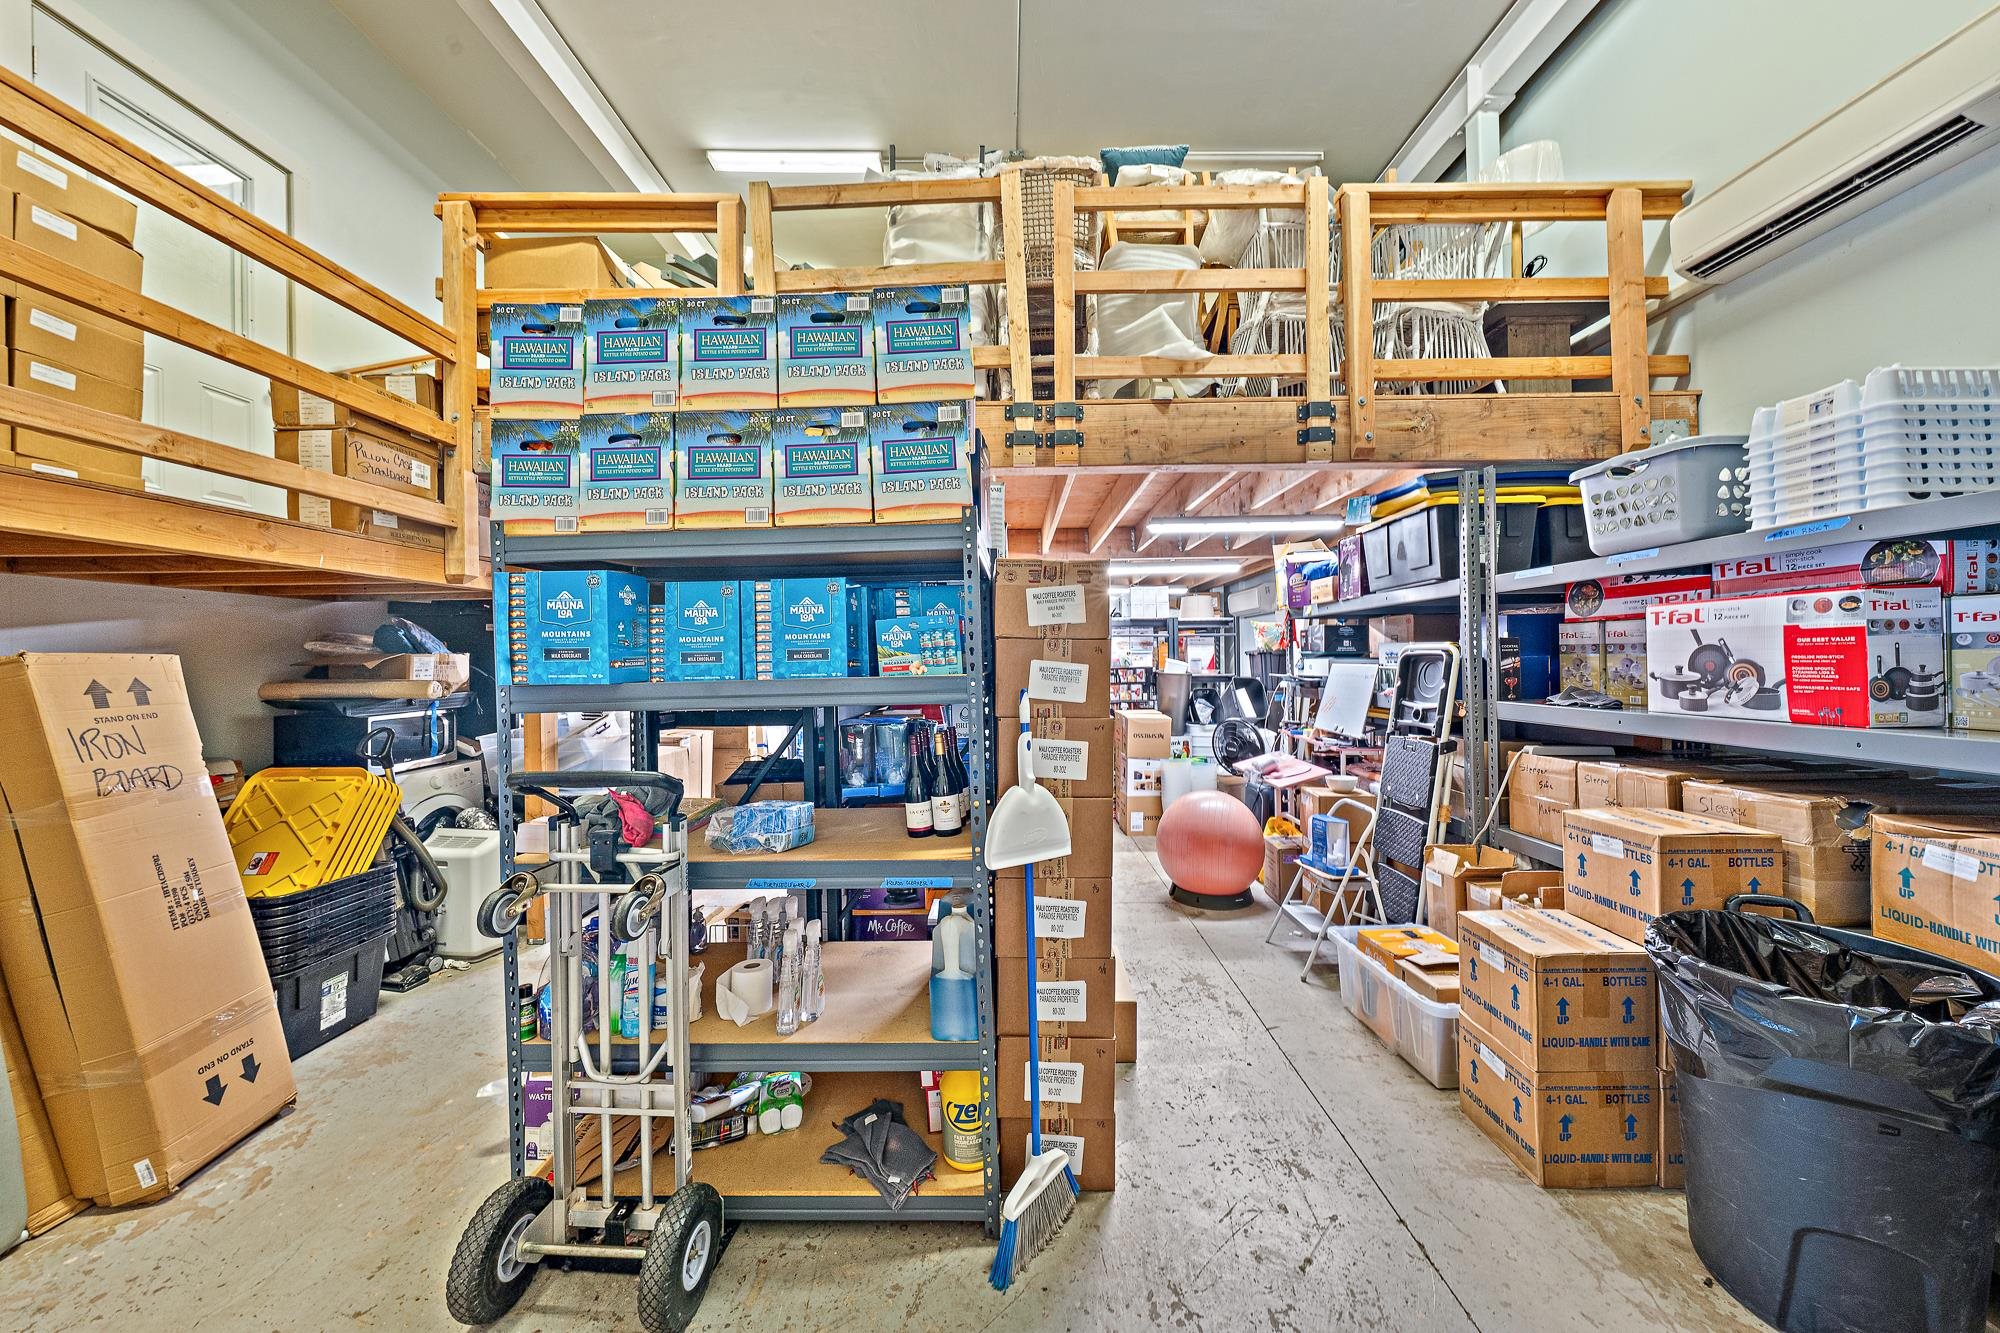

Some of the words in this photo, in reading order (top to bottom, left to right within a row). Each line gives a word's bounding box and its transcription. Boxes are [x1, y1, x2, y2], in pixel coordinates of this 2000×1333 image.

[885, 360, 928, 373] ISLAND
[933, 358, 964, 370] PACK
[594, 371, 636, 382] ISLAND
[640, 369, 670, 381] PACK
[691, 368, 735, 380] ISLAND
[739, 367, 769, 379] PACK
[500, 377, 541, 389] ISLAND
[546, 377, 575, 389] PACK
[350, 441, 389, 464] PILLOW
[783, 484, 826, 496] ISLAND
[831, 482, 862, 495] PACK
[882, 480, 925, 493] ISLAND
[930, 477, 961, 490] PACK
[685, 487, 728, 498] ISLAND
[731, 485, 764, 497] PACK
[499, 495, 539, 506] ISLAND
[544, 495, 572, 507] PACK
[1714, 557, 1776, 578] T-fal
[1967, 552, 1978, 593] T-fal
[547, 601, 584, 609] MAUNA
[790, 606, 824, 614] MAUNA
[1869, 600, 1910, 611] T-fal
[558, 610, 573, 618] LOA
[685, 609, 718, 618] MAUNA
[801, 614, 814, 622] LOA
[1651, 608, 1704, 625] T-fal
[882, 633, 912, 641] MAUNA
[94, 716, 123, 724] STAND
[67, 725, 146, 763] IRON
[1059, 754, 1080, 762] PROPERTIES
[93, 765, 183, 796] BOARD
[1885, 841, 1904, 854] 4-1
[1669, 860, 1684, 868] 4-1
[1688, 859, 1710, 868] GAL.
[1729, 857, 1773, 867] BOTTLES
[187, 858, 201, 886] TURKEY
[1579, 869, 1587, 878] UP
[1630, 887, 1641, 897] UP
[180, 886, 189, 901] PCS
[198, 887, 204, 896] IN
[1899, 888, 1915, 899] UP
[1682, 897, 1695, 905] UP
[199, 897, 211, 919] MADE
[1620, 904, 1637, 919] WITH
[1057, 913, 1078, 921] PROPERTIES
[868, 920, 884, 932] Mr.
[885, 918, 915, 936] Coffee
[1544, 977, 1559, 987] 4-1
[1562, 977, 1584, 986] GAL.
[1603, 977, 1647, 986] BOTTLES
[1557, 1016, 1569, 1024] UP
[1623, 1016, 1635, 1024] UP
[231, 1038, 254, 1055] STAND
[1542, 1038, 1607, 1048] LIQUID-HANDLE
[1610, 1037, 1629, 1047] WITH
[1632, 1036, 1650, 1046] CARE
[217, 1053, 229, 1064] ON
[198, 1061, 215, 1075] END
[1546, 1095, 1561, 1105] 4-1
[1565, 1095, 1587, 1105] GAL.
[1606, 1094, 1649, 1105] BOTTLES
[1560, 1133, 1572, 1142] UP
[1625, 1133, 1638, 1141] UP
